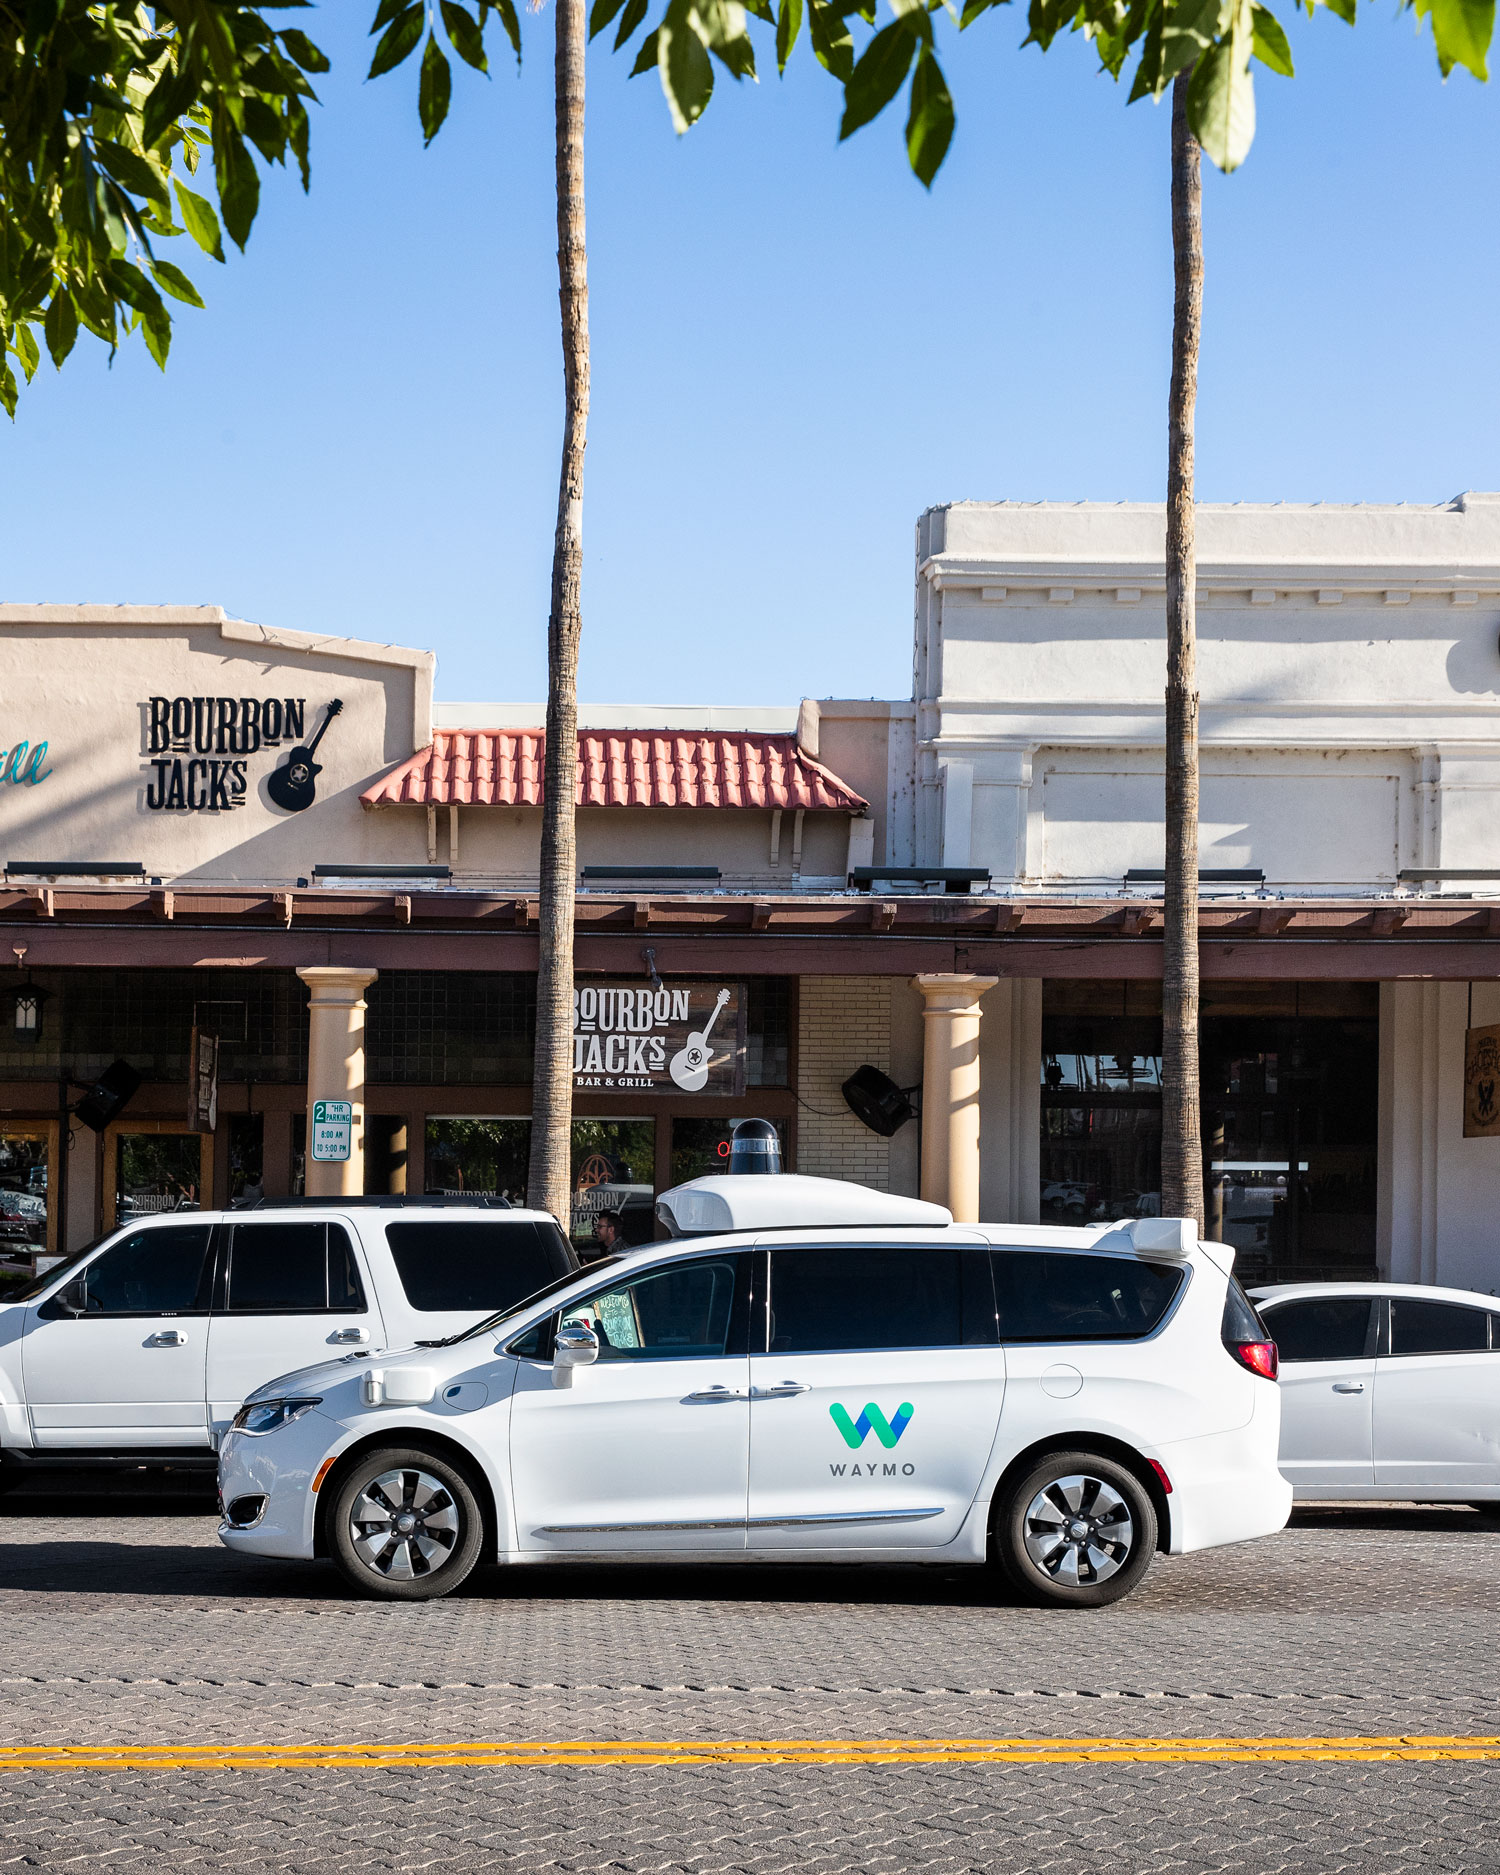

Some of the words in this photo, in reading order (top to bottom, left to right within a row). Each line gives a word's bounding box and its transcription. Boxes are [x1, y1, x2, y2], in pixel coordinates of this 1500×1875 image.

[148, 696, 306, 754] BOURBON
[147, 759, 248, 811] JACKS
[577, 1076, 602, 1087] BAR
[605, 1077, 615, 1087] &
[618, 1077, 654, 1087] GRILL
[315, 1105, 325, 1120] 2
[334, 1104, 344, 1113] HR
[326, 1114, 350, 1122] PARKING
[321, 1130, 334, 1139] 8:00
[335, 1130, 343, 1139] AM
[316, 1144, 324, 1152] TO
[325, 1144, 338, 1152] 5:00
[340, 1144, 347, 1152] PM
[131, 1194, 175, 1211] BOURBON
[829, 1462, 916, 1477] WAYMO
